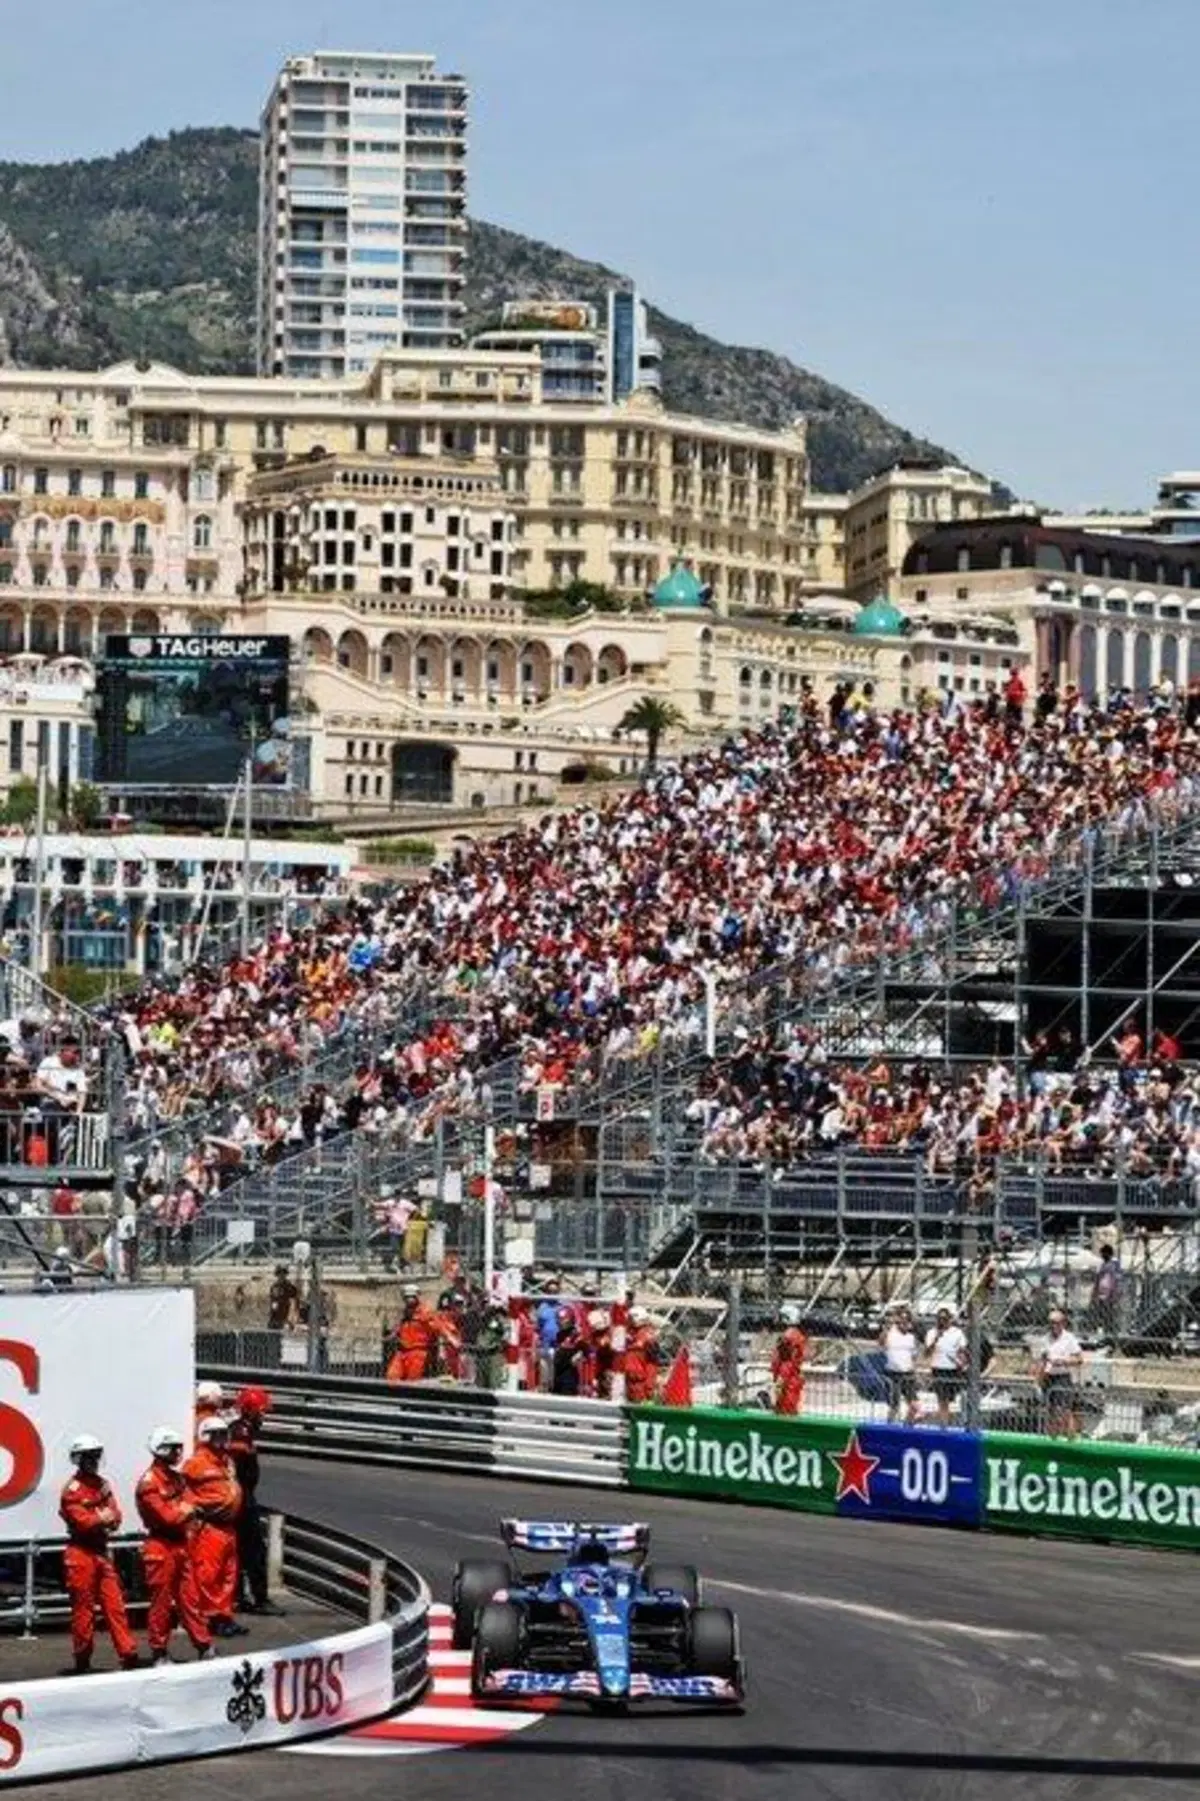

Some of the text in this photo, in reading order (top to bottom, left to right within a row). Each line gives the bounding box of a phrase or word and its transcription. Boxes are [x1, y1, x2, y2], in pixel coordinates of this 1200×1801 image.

[635, 1421, 822, 1488] Heineken
[985, 1457, 1200, 1527] Heineken
[273, 1653, 344, 1724] UBS
